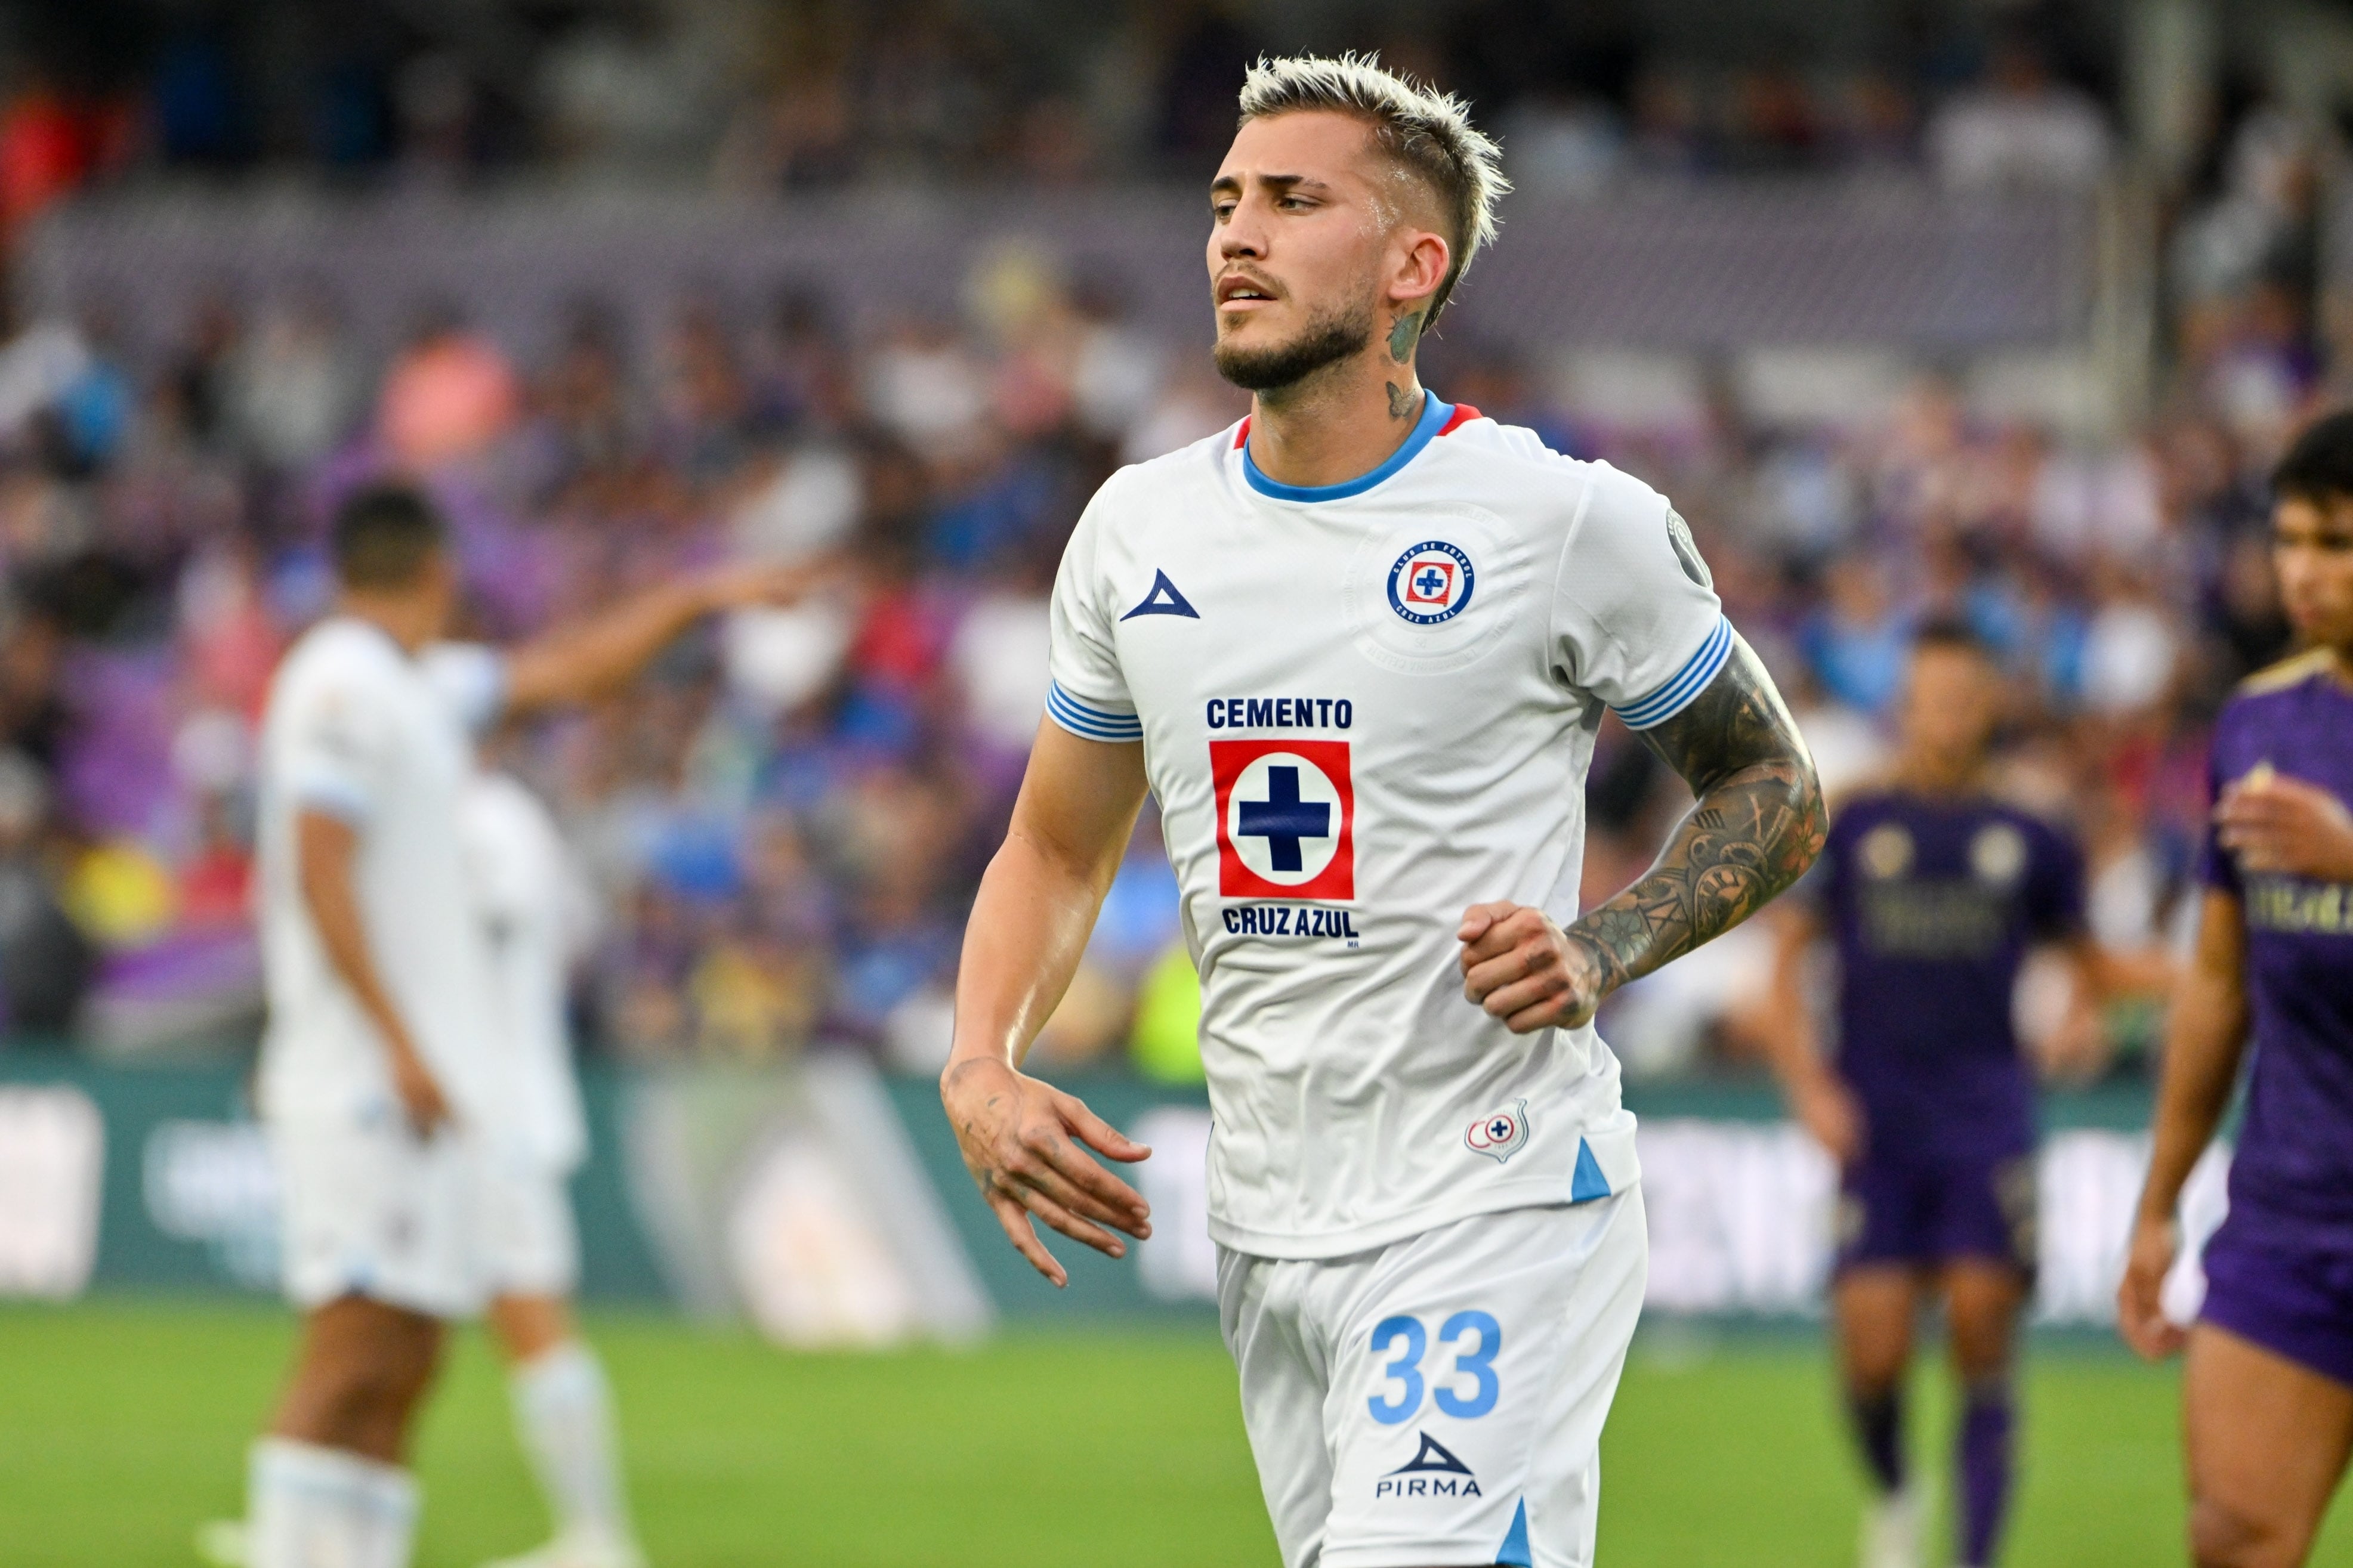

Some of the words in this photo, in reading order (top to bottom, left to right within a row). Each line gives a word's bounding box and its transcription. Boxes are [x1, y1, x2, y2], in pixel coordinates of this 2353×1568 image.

[1394, 550, 1415, 573] CLUB
[1443, 545, 1472, 578] FUTBOL
[1396, 605, 1420, 622] CRUZ
[1428, 610, 1455, 623] AZUL
[1207, 698, 1352, 729] CEMENTO
[1222, 907, 1290, 935] CRUZ
[1295, 909, 1359, 938] AZUL
[1368, 1310, 1501, 1425] 33
[1376, 1479, 1482, 1498] PIRMA
